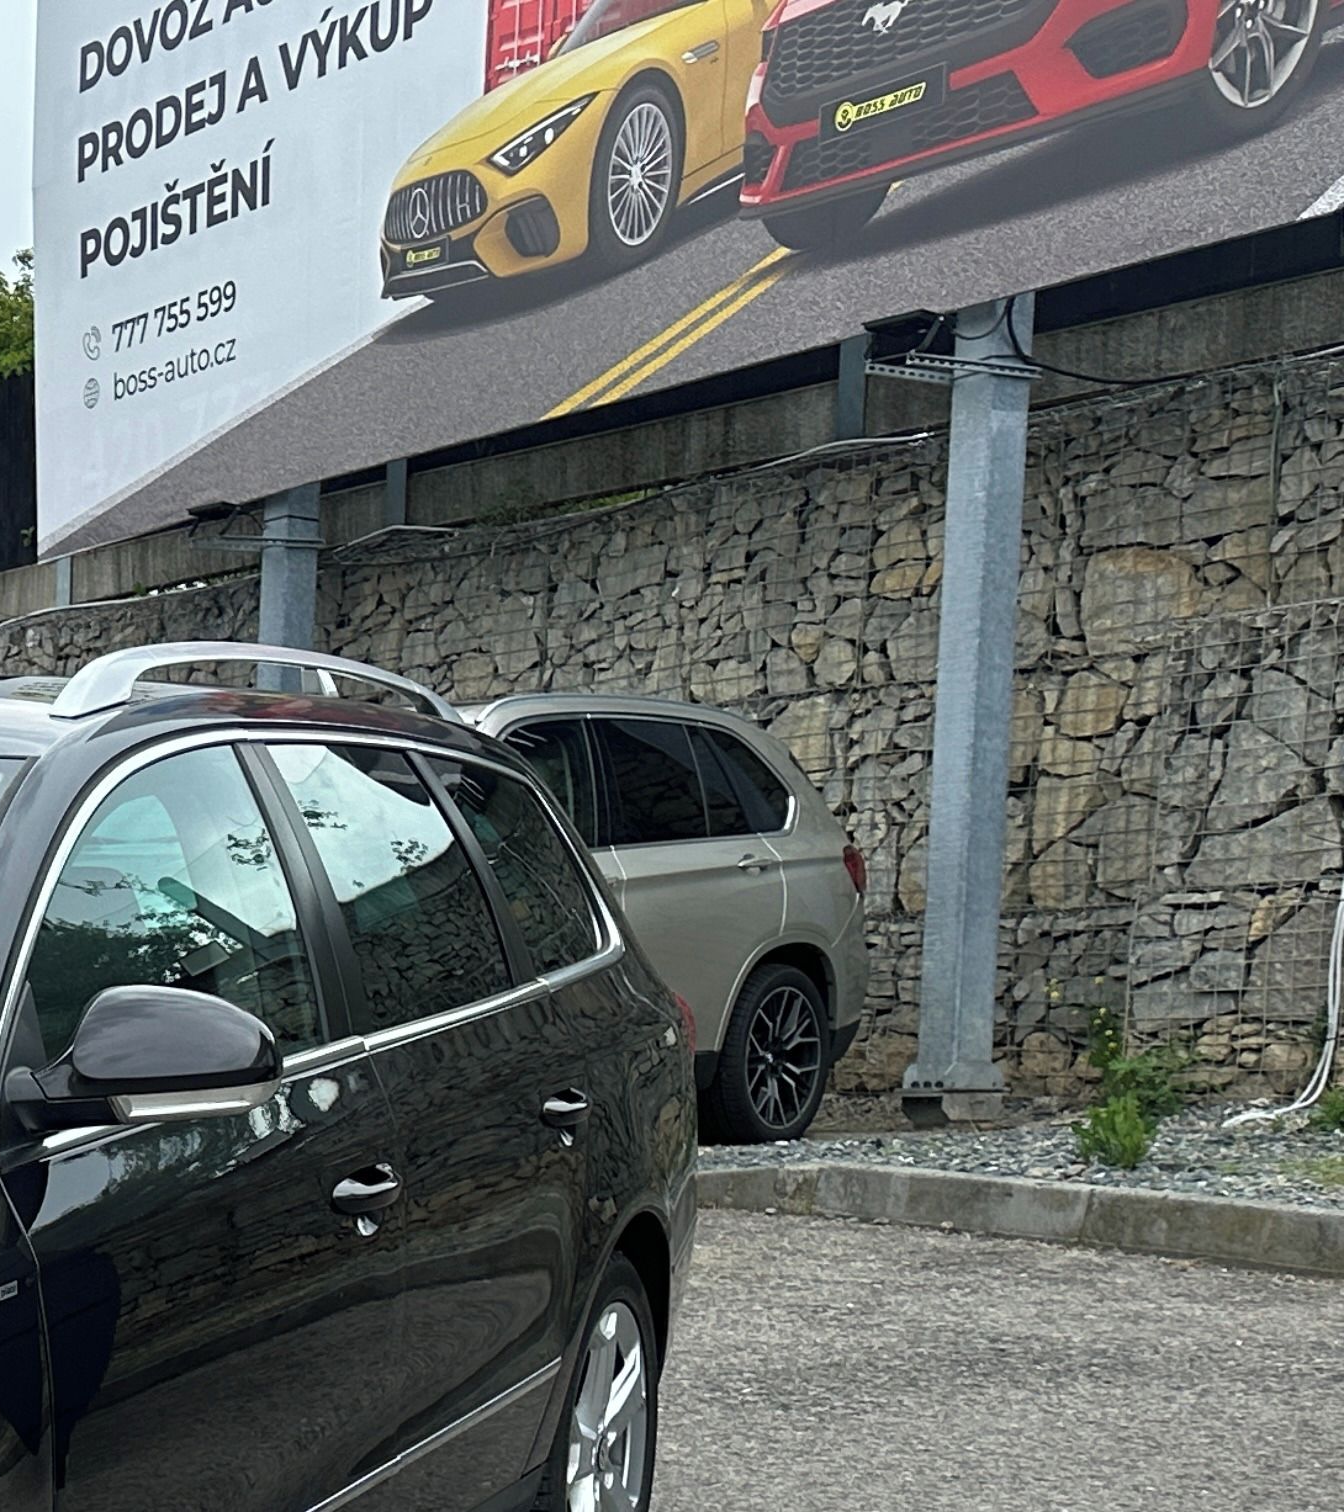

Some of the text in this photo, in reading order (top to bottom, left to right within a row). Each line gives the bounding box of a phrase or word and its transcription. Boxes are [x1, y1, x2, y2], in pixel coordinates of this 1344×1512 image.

[77, 0, 433, 184] PRODEJ A VÝKUP
[78, 0, 214, 95] DOVOZ
[80, 138, 276, 280] POJIŠTĚNÍ
[112, 280, 237, 353] 777 755 599
[113, 338, 237, 401] boss-auto.cz
